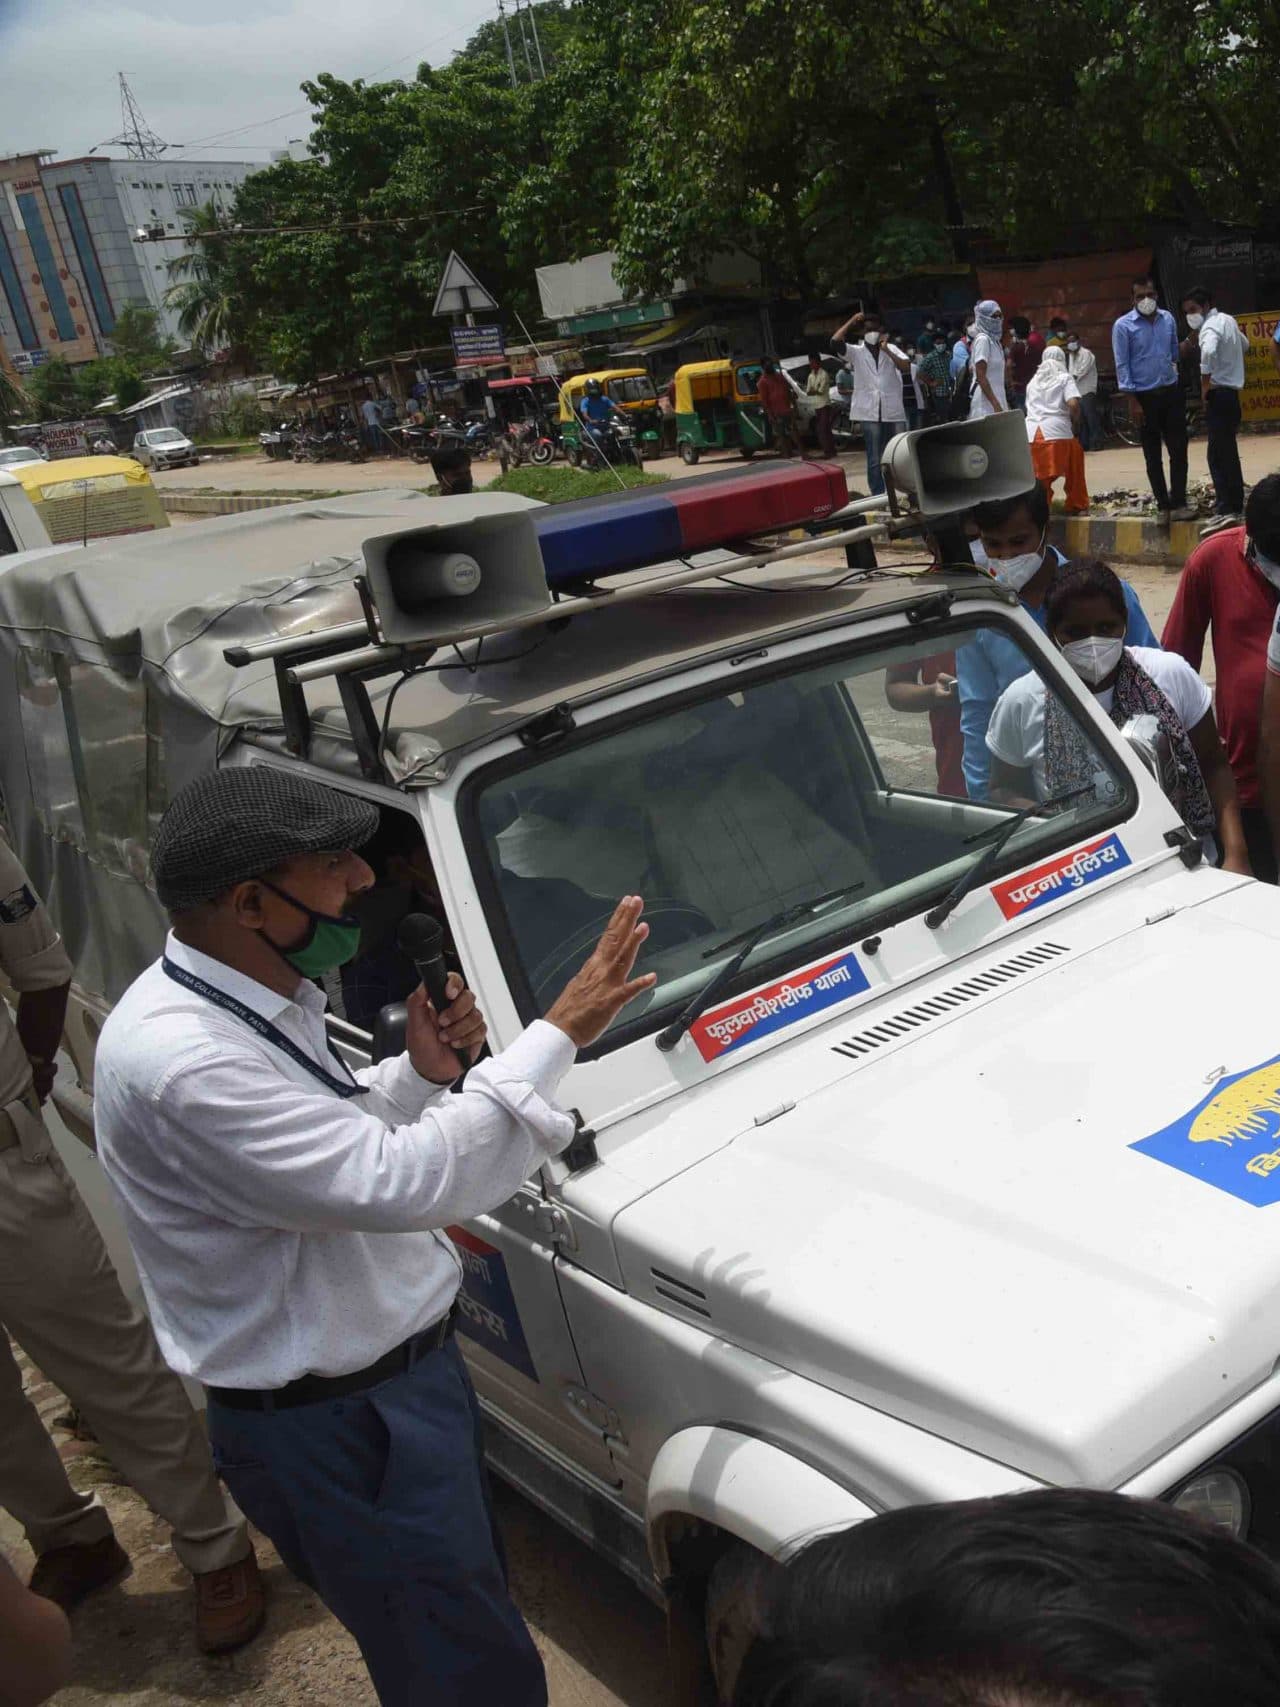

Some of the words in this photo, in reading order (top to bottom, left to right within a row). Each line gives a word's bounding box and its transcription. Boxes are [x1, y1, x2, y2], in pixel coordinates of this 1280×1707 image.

[45, 437, 78, 449] WORLD
[1008, 871, 1063, 903] पटना
[1060, 844, 1119, 887] पुलिस
[175, 969, 194, 987] PATNA
[705, 981, 813, 1045] फुलवारीशरीफ
[814, 965, 852, 991] थाना
